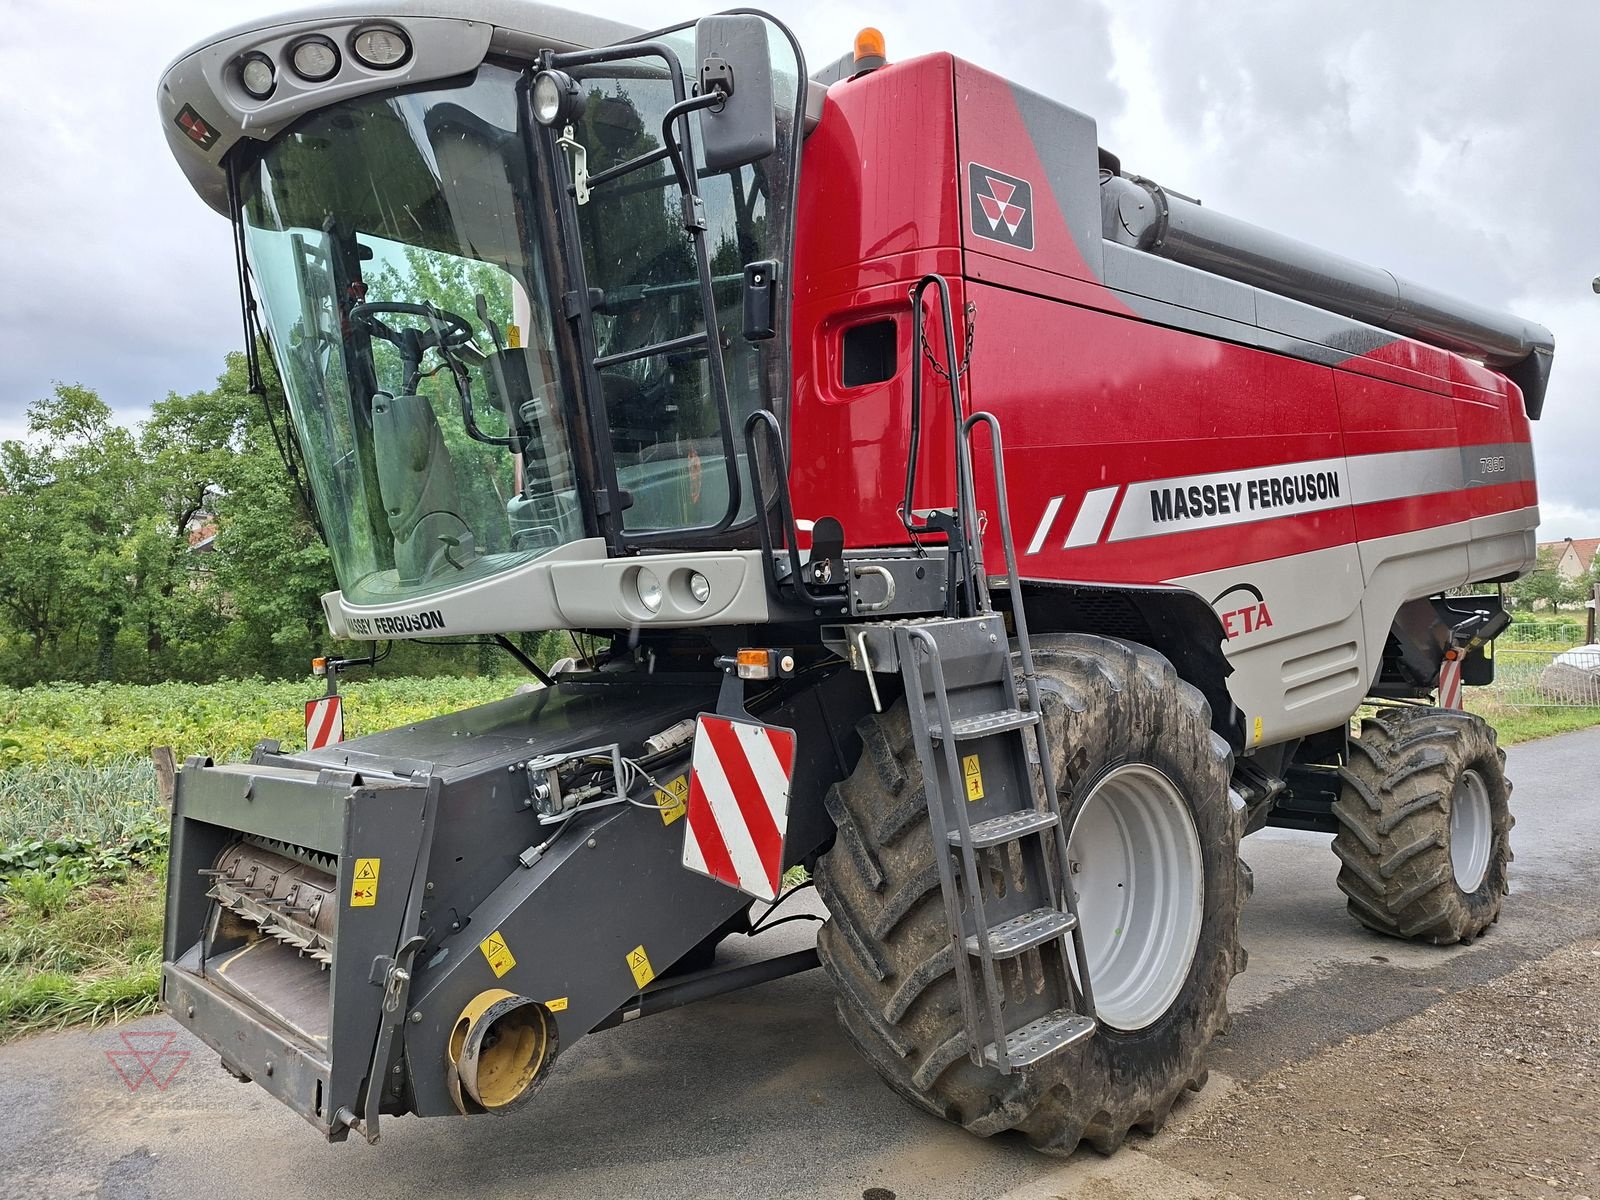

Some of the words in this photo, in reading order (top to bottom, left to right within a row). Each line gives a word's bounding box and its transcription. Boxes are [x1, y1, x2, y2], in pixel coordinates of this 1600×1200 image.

[1150, 482, 1242, 523] MASSEY
[1247, 471, 1340, 511] FERGUSON
[374, 609, 446, 635] FERGUSON
[1221, 602, 1274, 639] ETA
